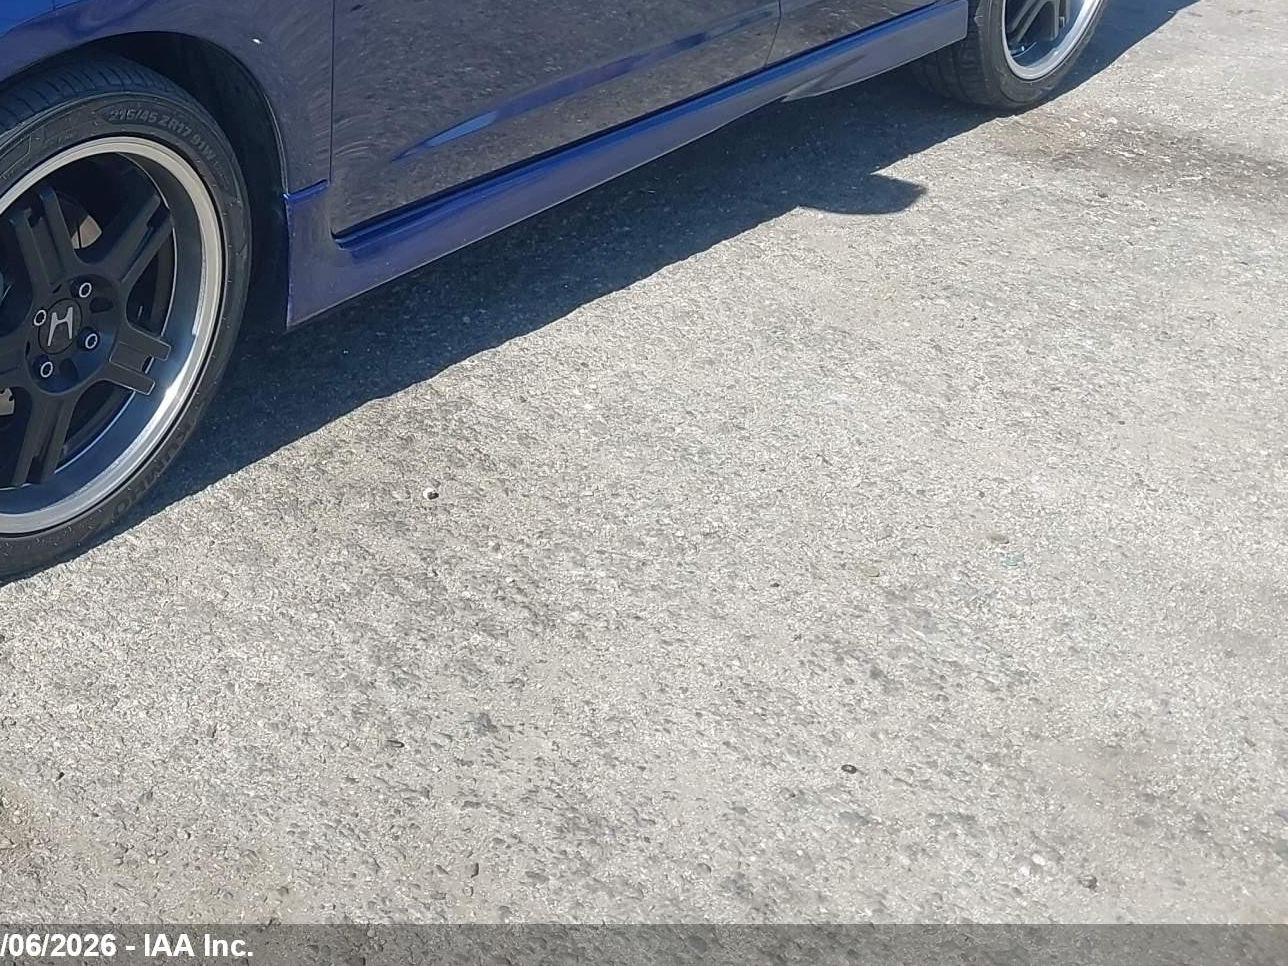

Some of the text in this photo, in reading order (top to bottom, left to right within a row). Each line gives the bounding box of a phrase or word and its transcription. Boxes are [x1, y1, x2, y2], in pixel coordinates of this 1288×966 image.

[107, 108, 216, 163] 215/45 ZR17 91W
